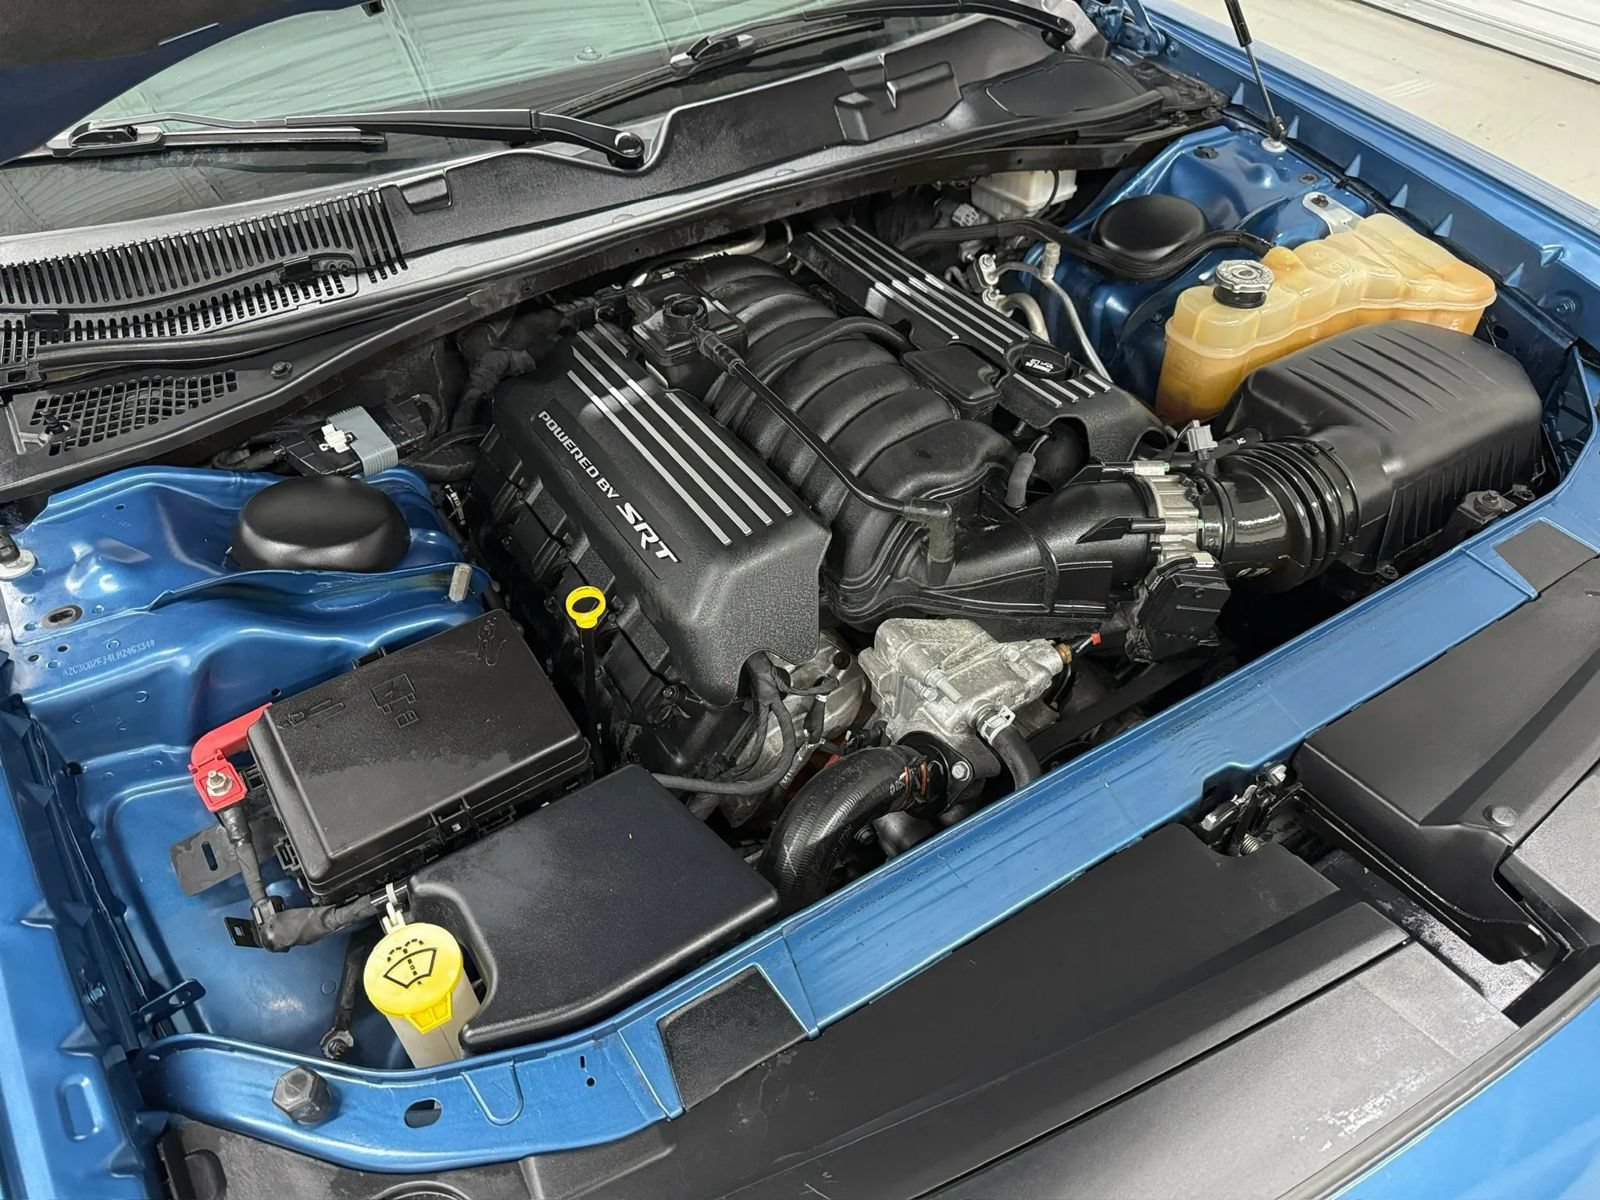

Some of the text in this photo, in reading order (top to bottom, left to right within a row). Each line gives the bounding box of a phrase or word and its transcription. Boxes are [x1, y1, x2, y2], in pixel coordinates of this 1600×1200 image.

[538, 410, 678, 563] POWERED BY SRT
